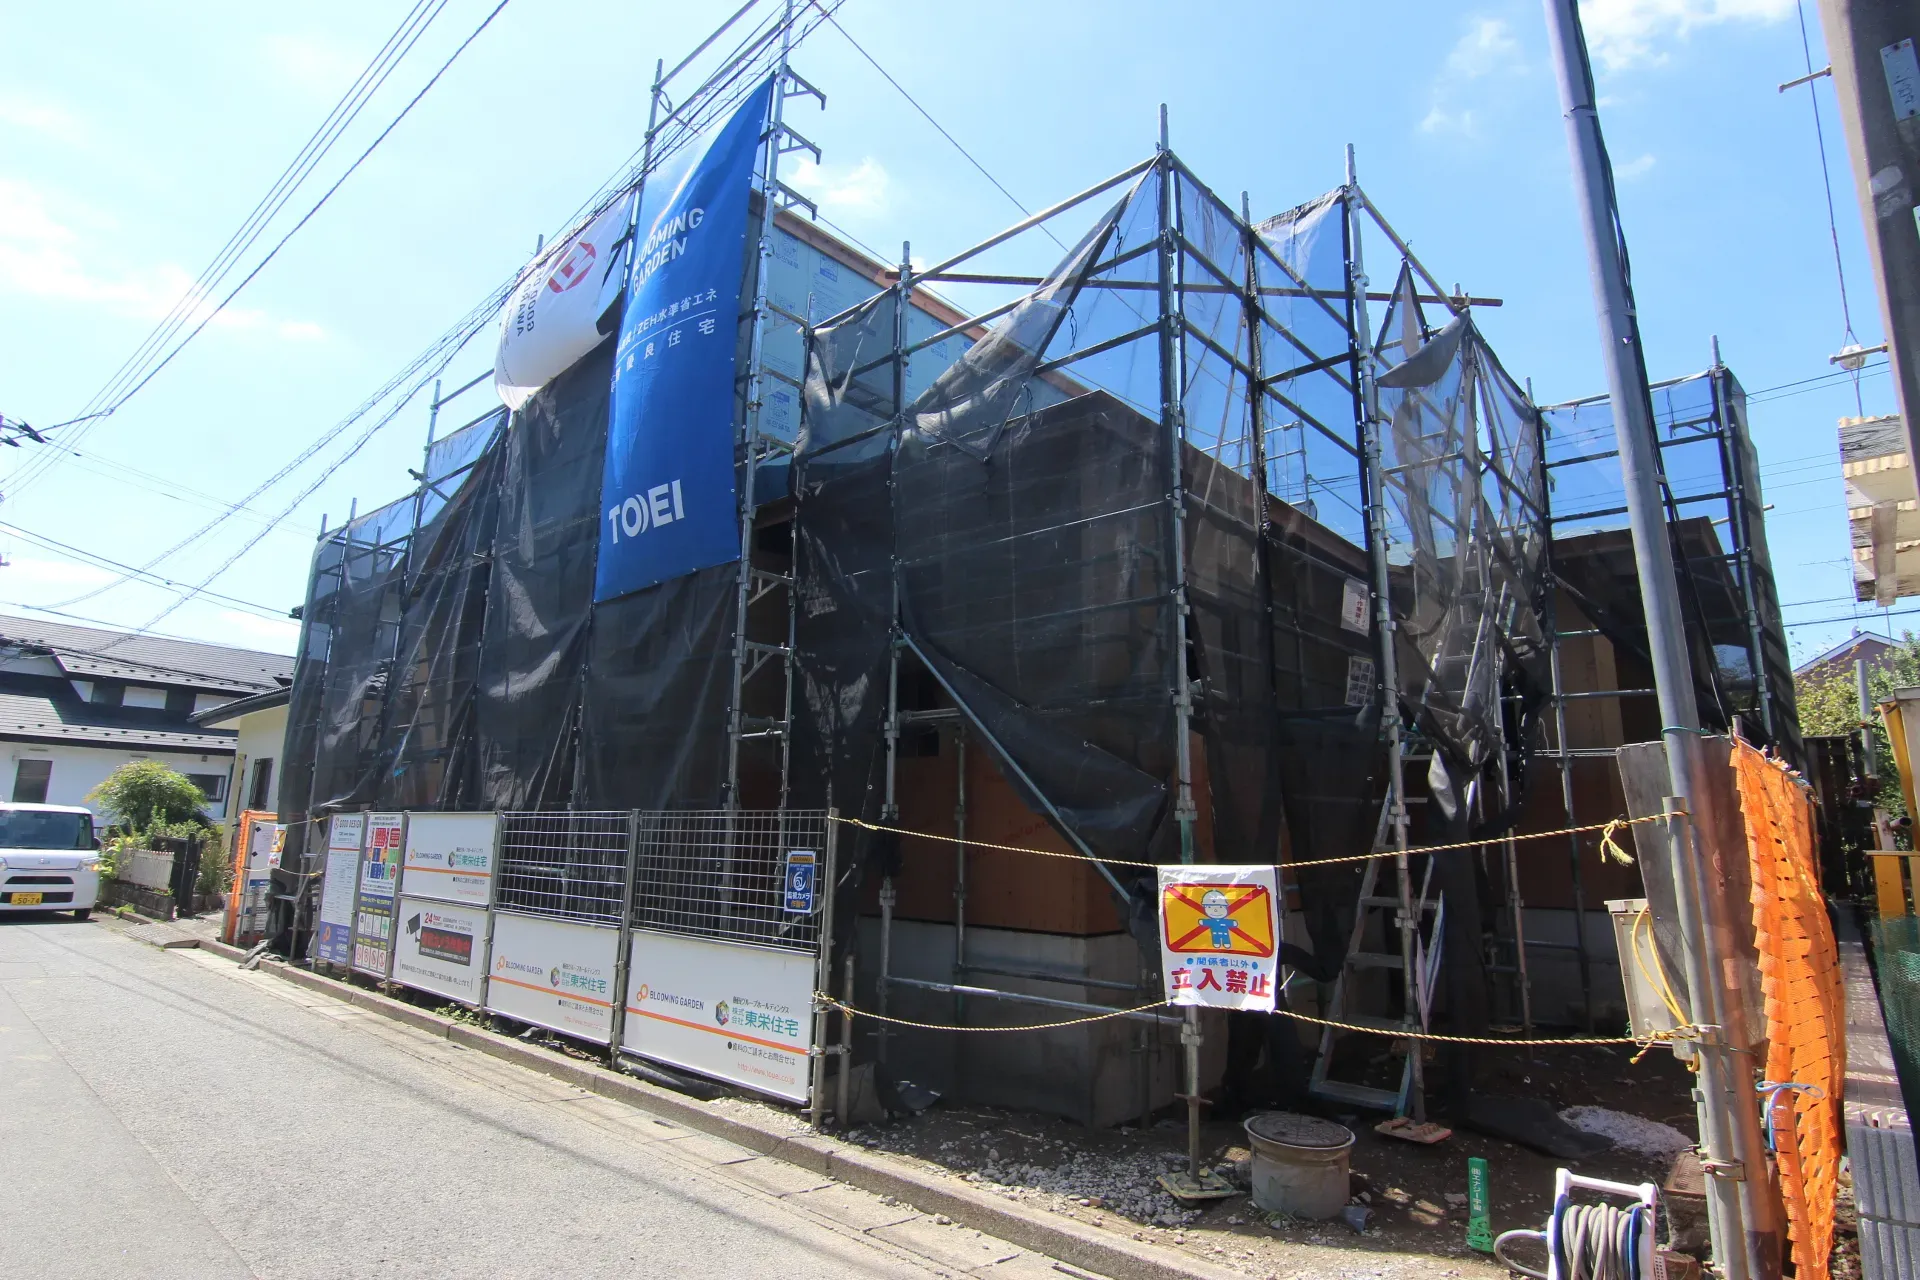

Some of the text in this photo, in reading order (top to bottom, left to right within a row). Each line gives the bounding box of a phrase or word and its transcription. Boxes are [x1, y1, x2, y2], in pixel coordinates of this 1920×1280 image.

[633, 237, 688, 296] GARDEN
[637, 288, 717, 335] ZEH水準省エネ
[608, 479, 685, 545] TOEI
[424, 912, 433, 924] 24
[505, 960, 543, 975] BLOOMING GARDEN
[1196, 957, 1250, 969] 関係者以外
[570, 974, 607, 993] 東栄住宅
[1171, 967, 1271, 998] 立入禁止
[650, 990, 705, 1011] BLOOMING GARDEN
[744, 1011, 799, 1037] 東栄住宅
